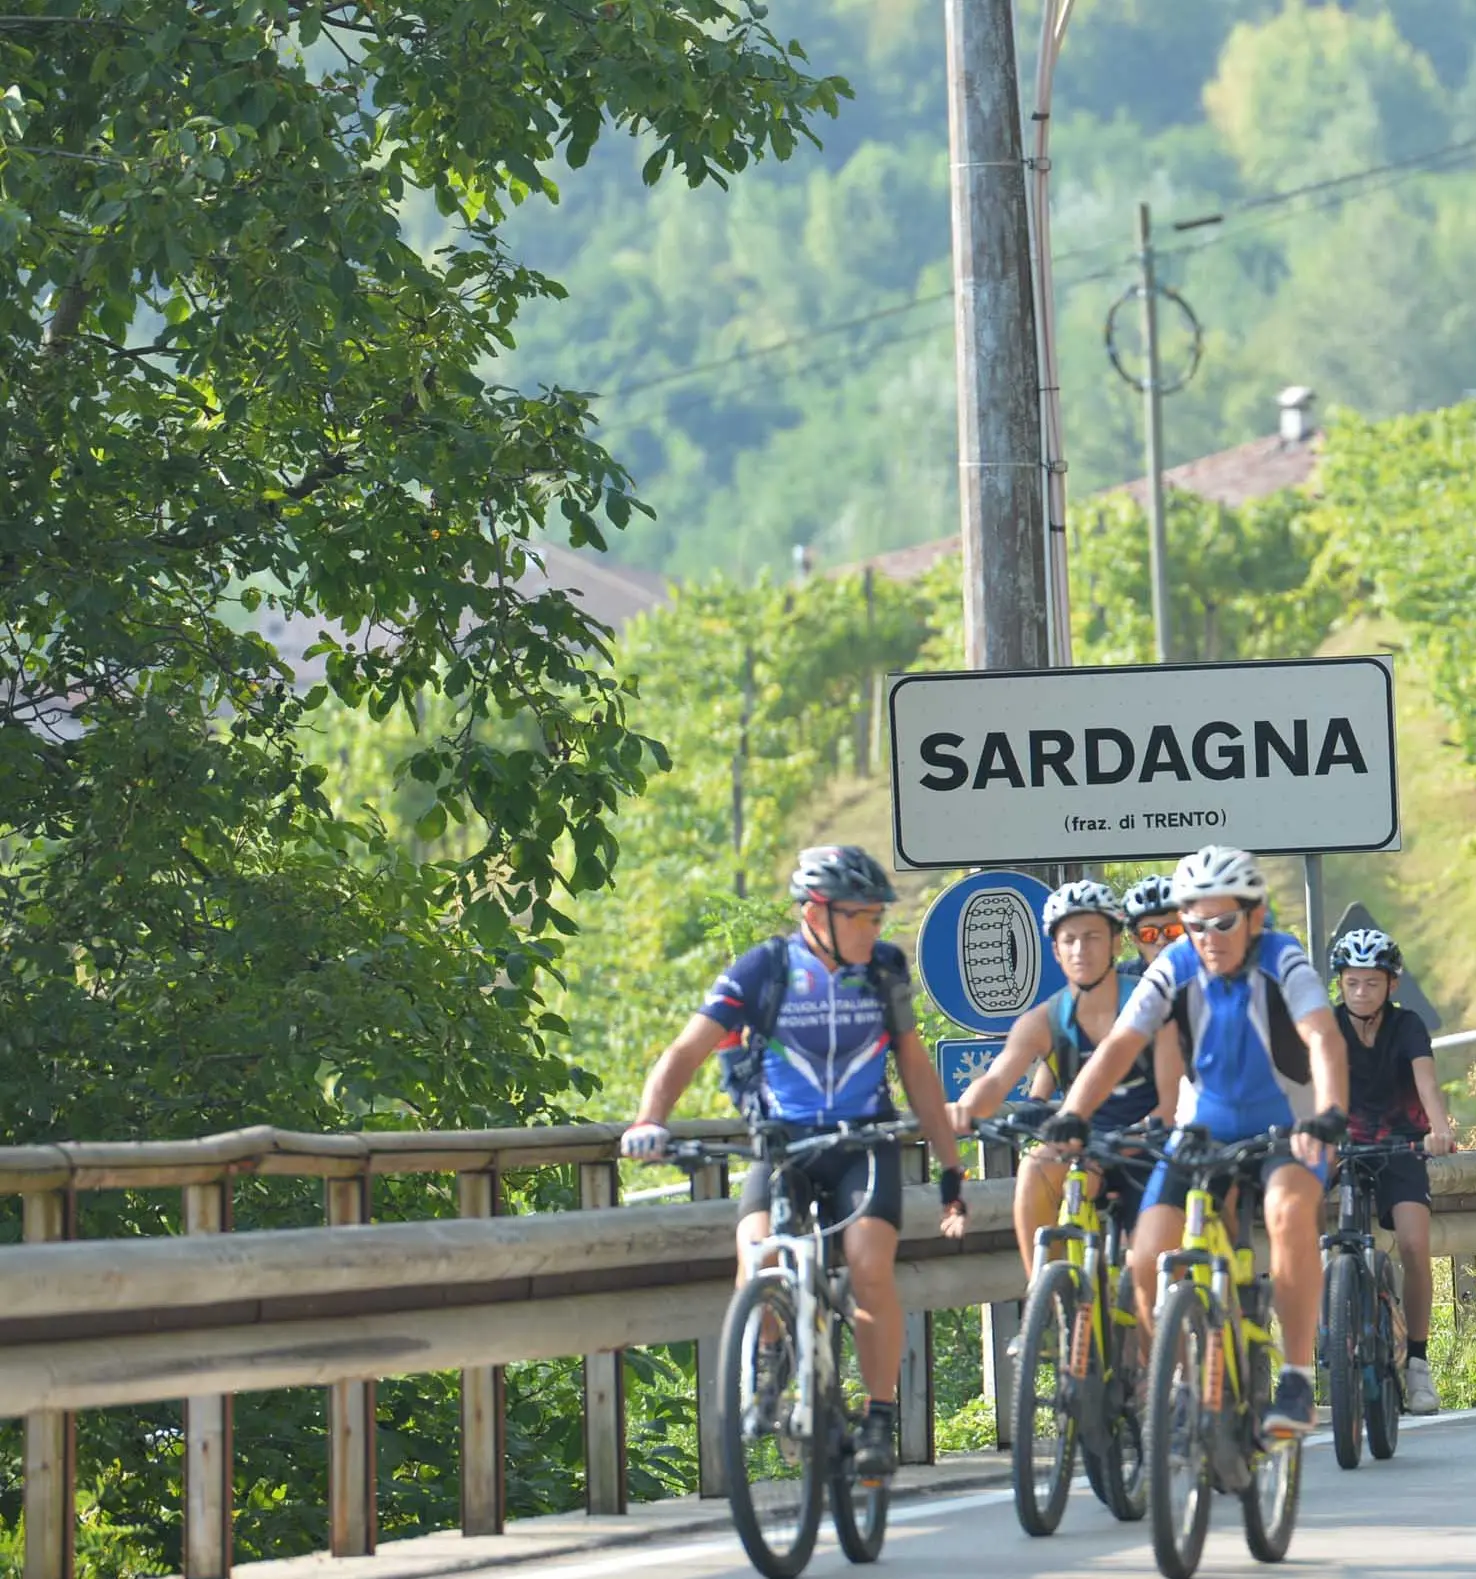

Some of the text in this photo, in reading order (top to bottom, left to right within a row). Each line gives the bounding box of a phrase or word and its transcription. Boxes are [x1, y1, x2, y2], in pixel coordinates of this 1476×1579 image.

[919, 717, 1369, 792] SARDAGNA
[1064, 808, 1227, 834] (fraz. di TRENTO)
